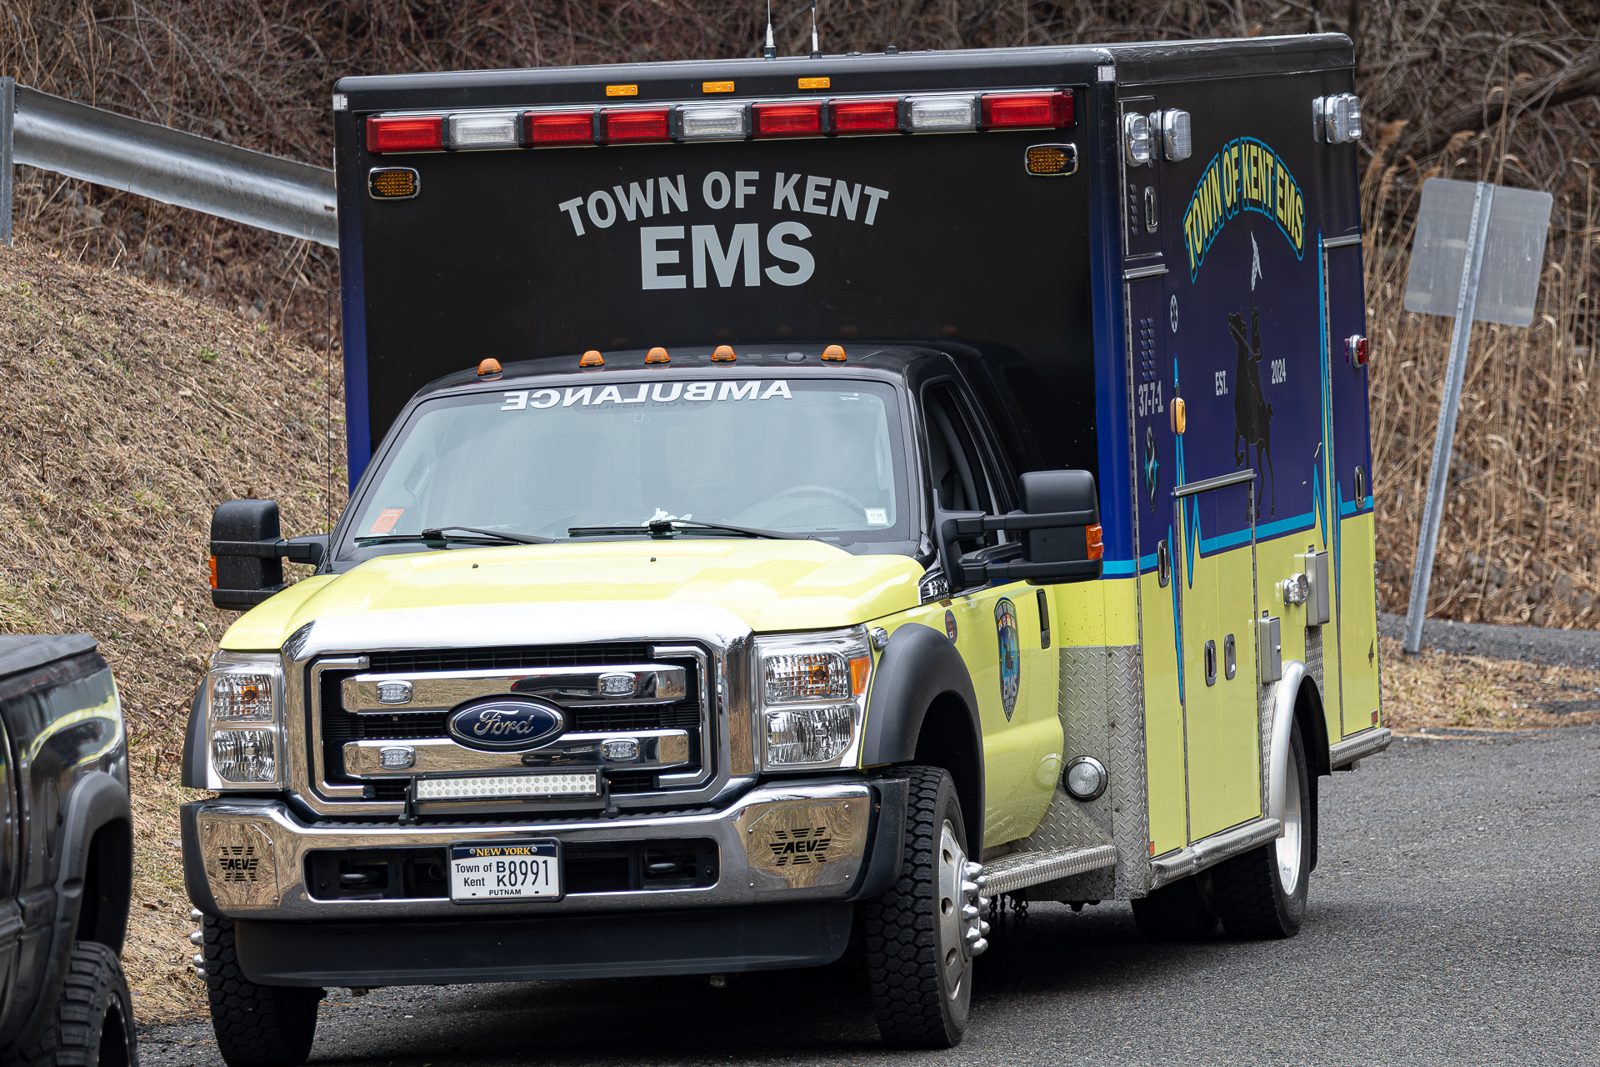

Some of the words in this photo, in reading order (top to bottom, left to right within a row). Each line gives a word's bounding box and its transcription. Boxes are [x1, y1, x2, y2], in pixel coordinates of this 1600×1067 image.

[558, 174, 689, 236] TOWN
[702, 171, 759, 209] OF
[773, 172, 889, 225] KENT
[1184, 161, 1223, 269] TOWN
[1223, 146, 1239, 208] OF
[1241, 143, 1273, 208] KENT
[1276, 167, 1304, 249] EMS
[640, 221, 815, 290] EMS
[1271, 358, 1287, 384] 2024
[1138, 381, 1164, 417] 37-7-1
[473, 709, 535, 736] Ford
[476, 848, 502, 857] NEW
[504, 847, 531, 856] YORK
[783, 840, 819, 854] AEV
[228, 859, 250, 870] AEV
[455, 863, 480, 874] Town
[483, 863, 493, 873] of
[463, 877, 486, 888] Kent
